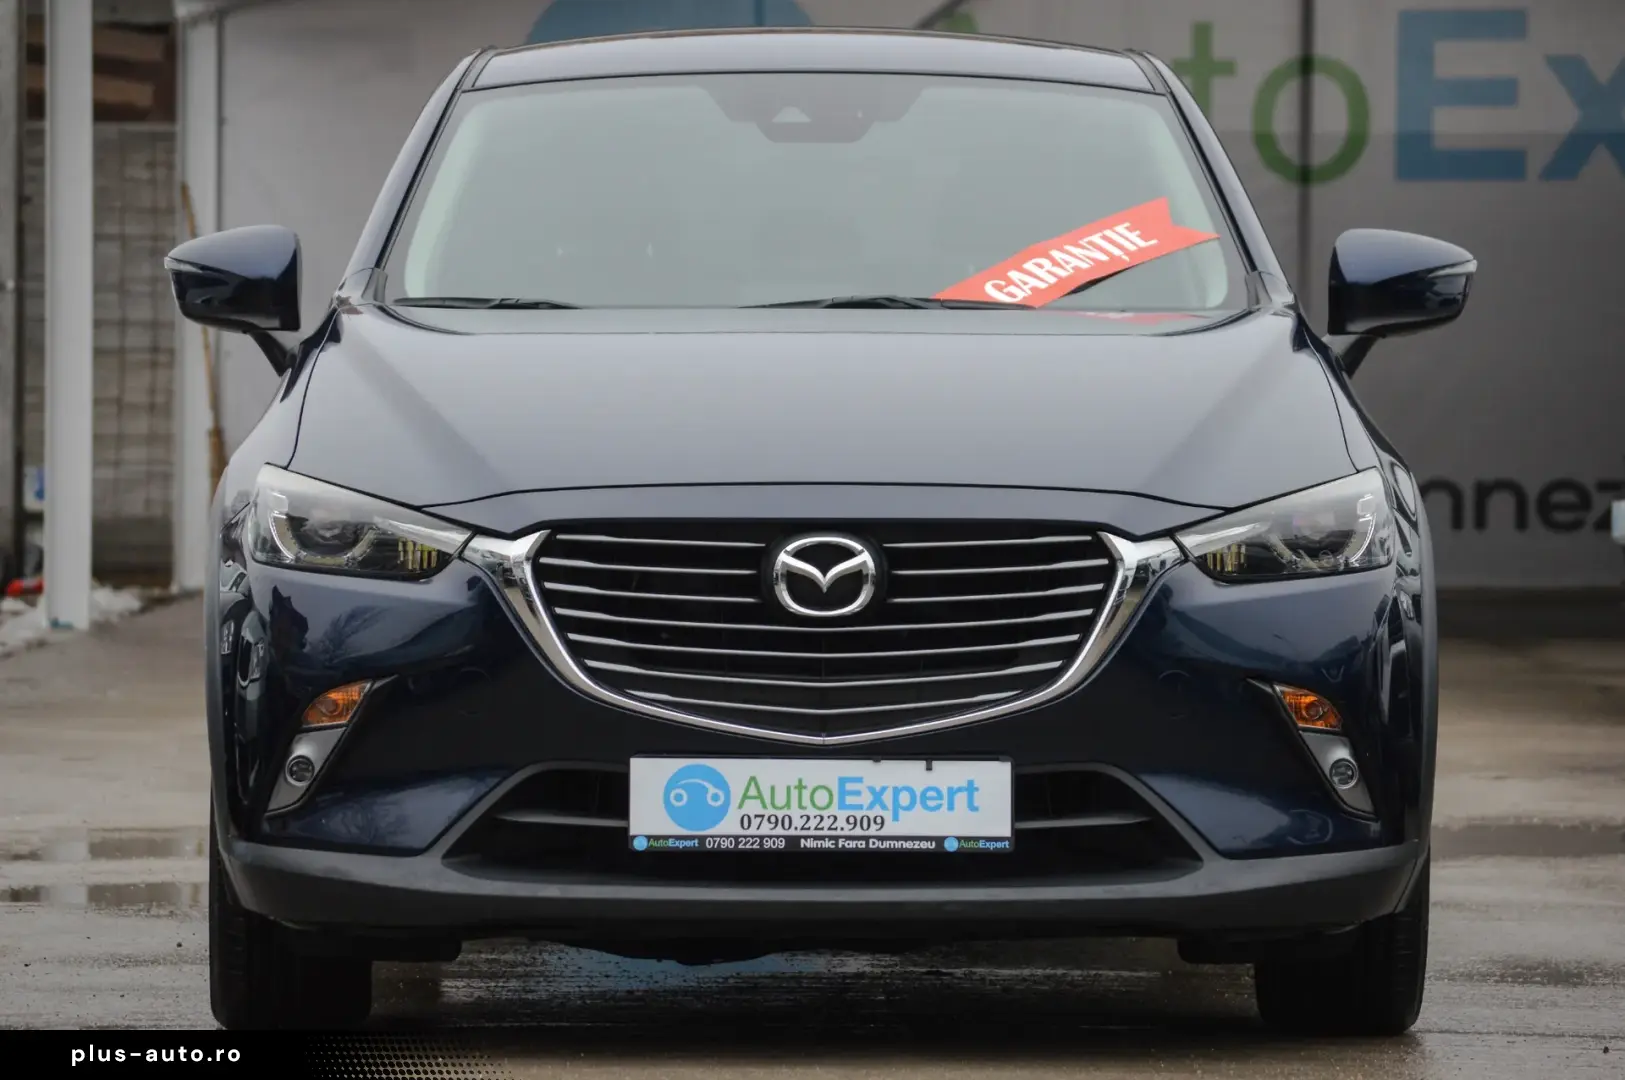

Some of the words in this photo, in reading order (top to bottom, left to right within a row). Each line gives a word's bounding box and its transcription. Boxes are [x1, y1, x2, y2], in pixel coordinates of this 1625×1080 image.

[737, 775, 980, 822] AutoExpert
[739, 813, 886, 832] 0790.222.909
[648, 838, 699, 848] AutoExpert
[705, 837, 735, 849] 0790
[738, 837, 760, 849] 222
[763, 837, 786, 849] 909
[800, 838, 835, 849] Nimic
[838, 839, 866, 849] Fara
[868, 839, 936, 849] Dumnezeu
[959, 839, 1010, 850] AutoExpert
